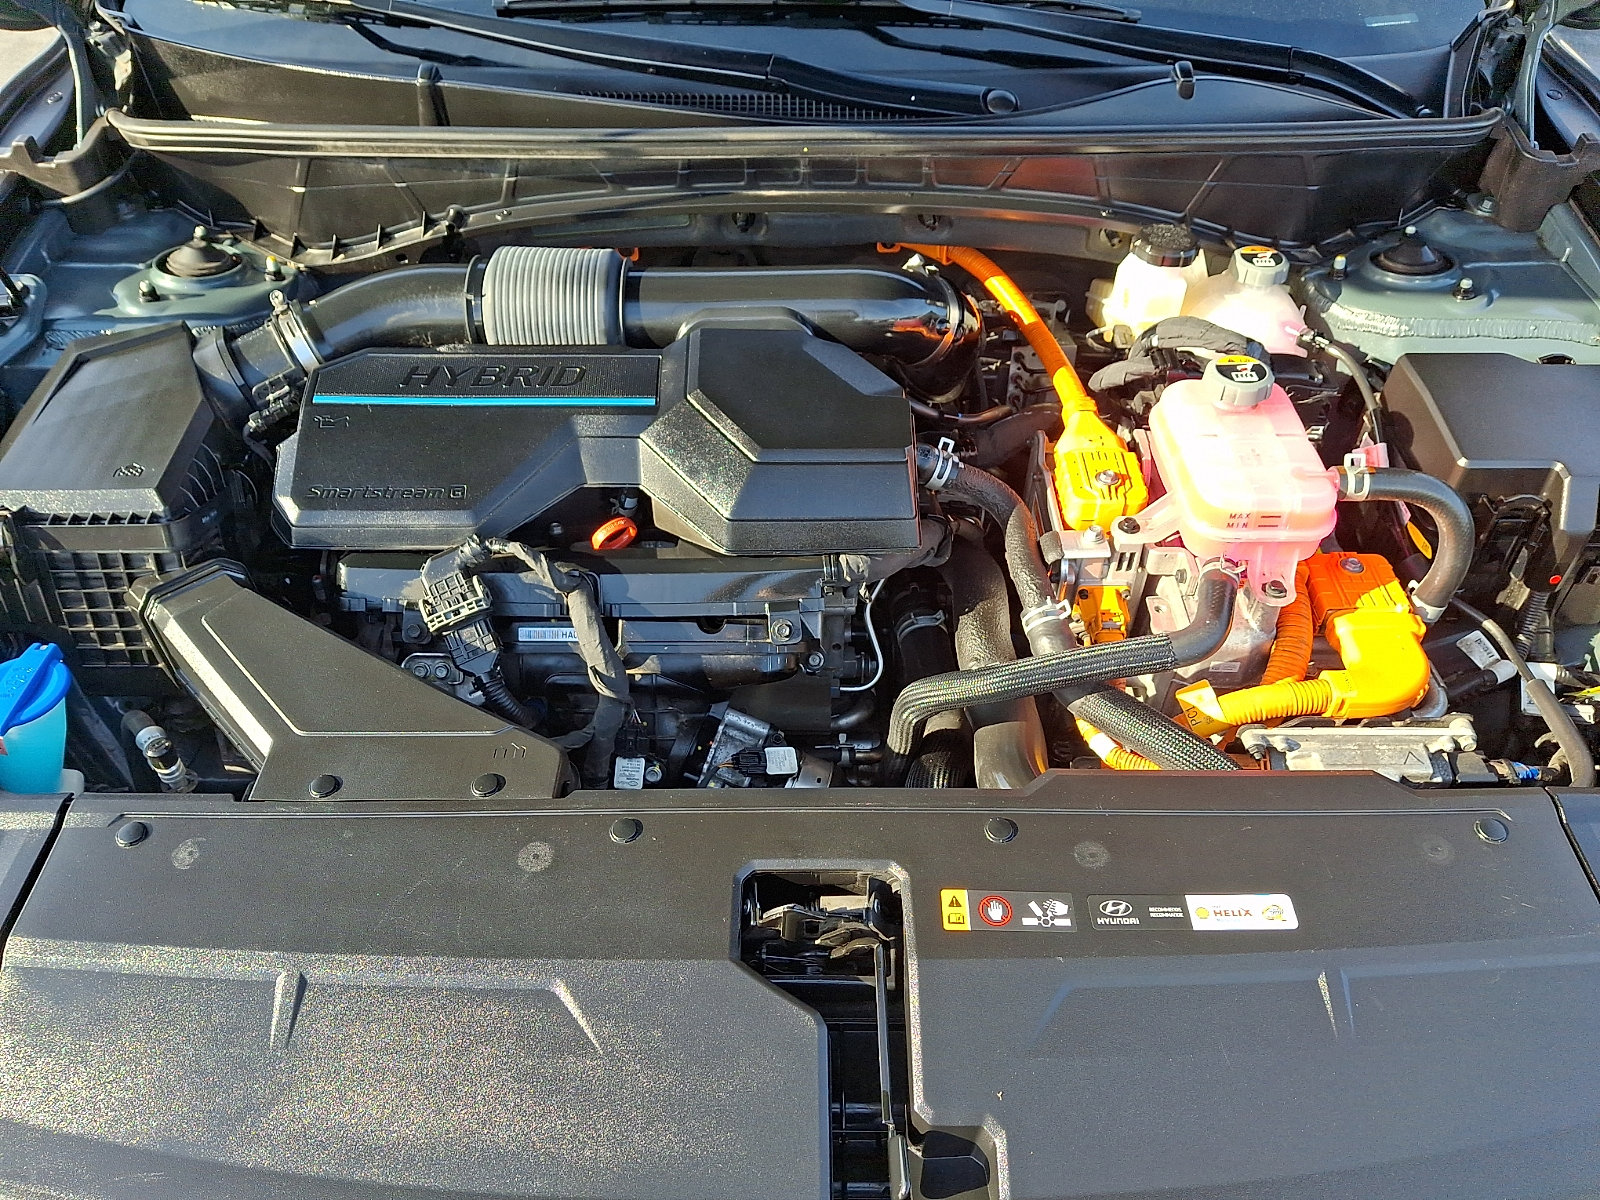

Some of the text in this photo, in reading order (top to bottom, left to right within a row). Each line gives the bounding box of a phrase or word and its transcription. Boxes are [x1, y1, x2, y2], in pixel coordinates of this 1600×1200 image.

[399, 364, 587, 388] HYBRID
[306, 484, 445, 500] Smartstream
[1229, 512, 1251, 520] MAX
[1213, 908, 1253, 917] HELIX
[1096, 917, 1140, 925] HYUNDAI
